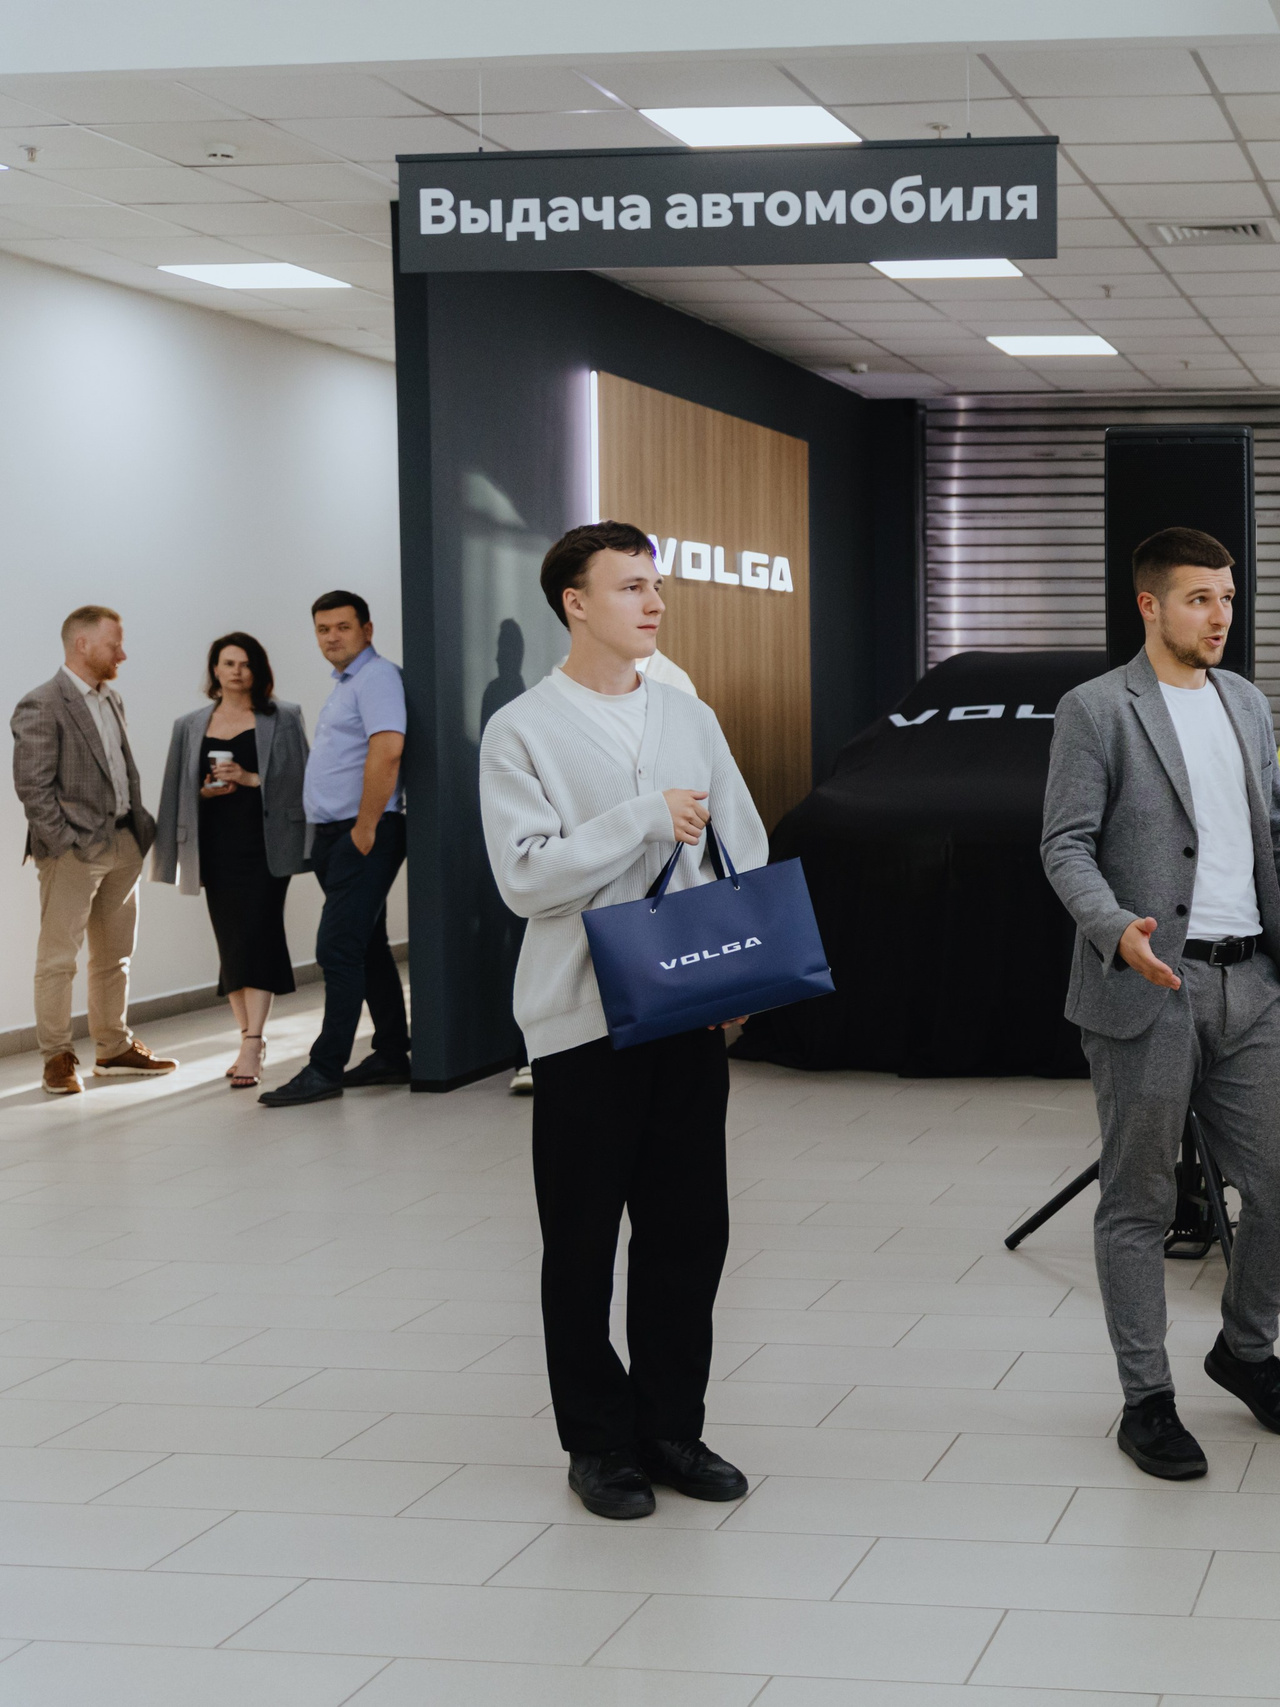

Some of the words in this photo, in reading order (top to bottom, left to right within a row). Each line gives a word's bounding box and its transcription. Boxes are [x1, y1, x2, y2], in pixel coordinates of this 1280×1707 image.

[419, 187, 652, 242] Выдача
[664, 173, 1039, 229] автомобиля
[646, 533, 794, 593] VOLGA
[659, 936, 763, 970] VOLGA
